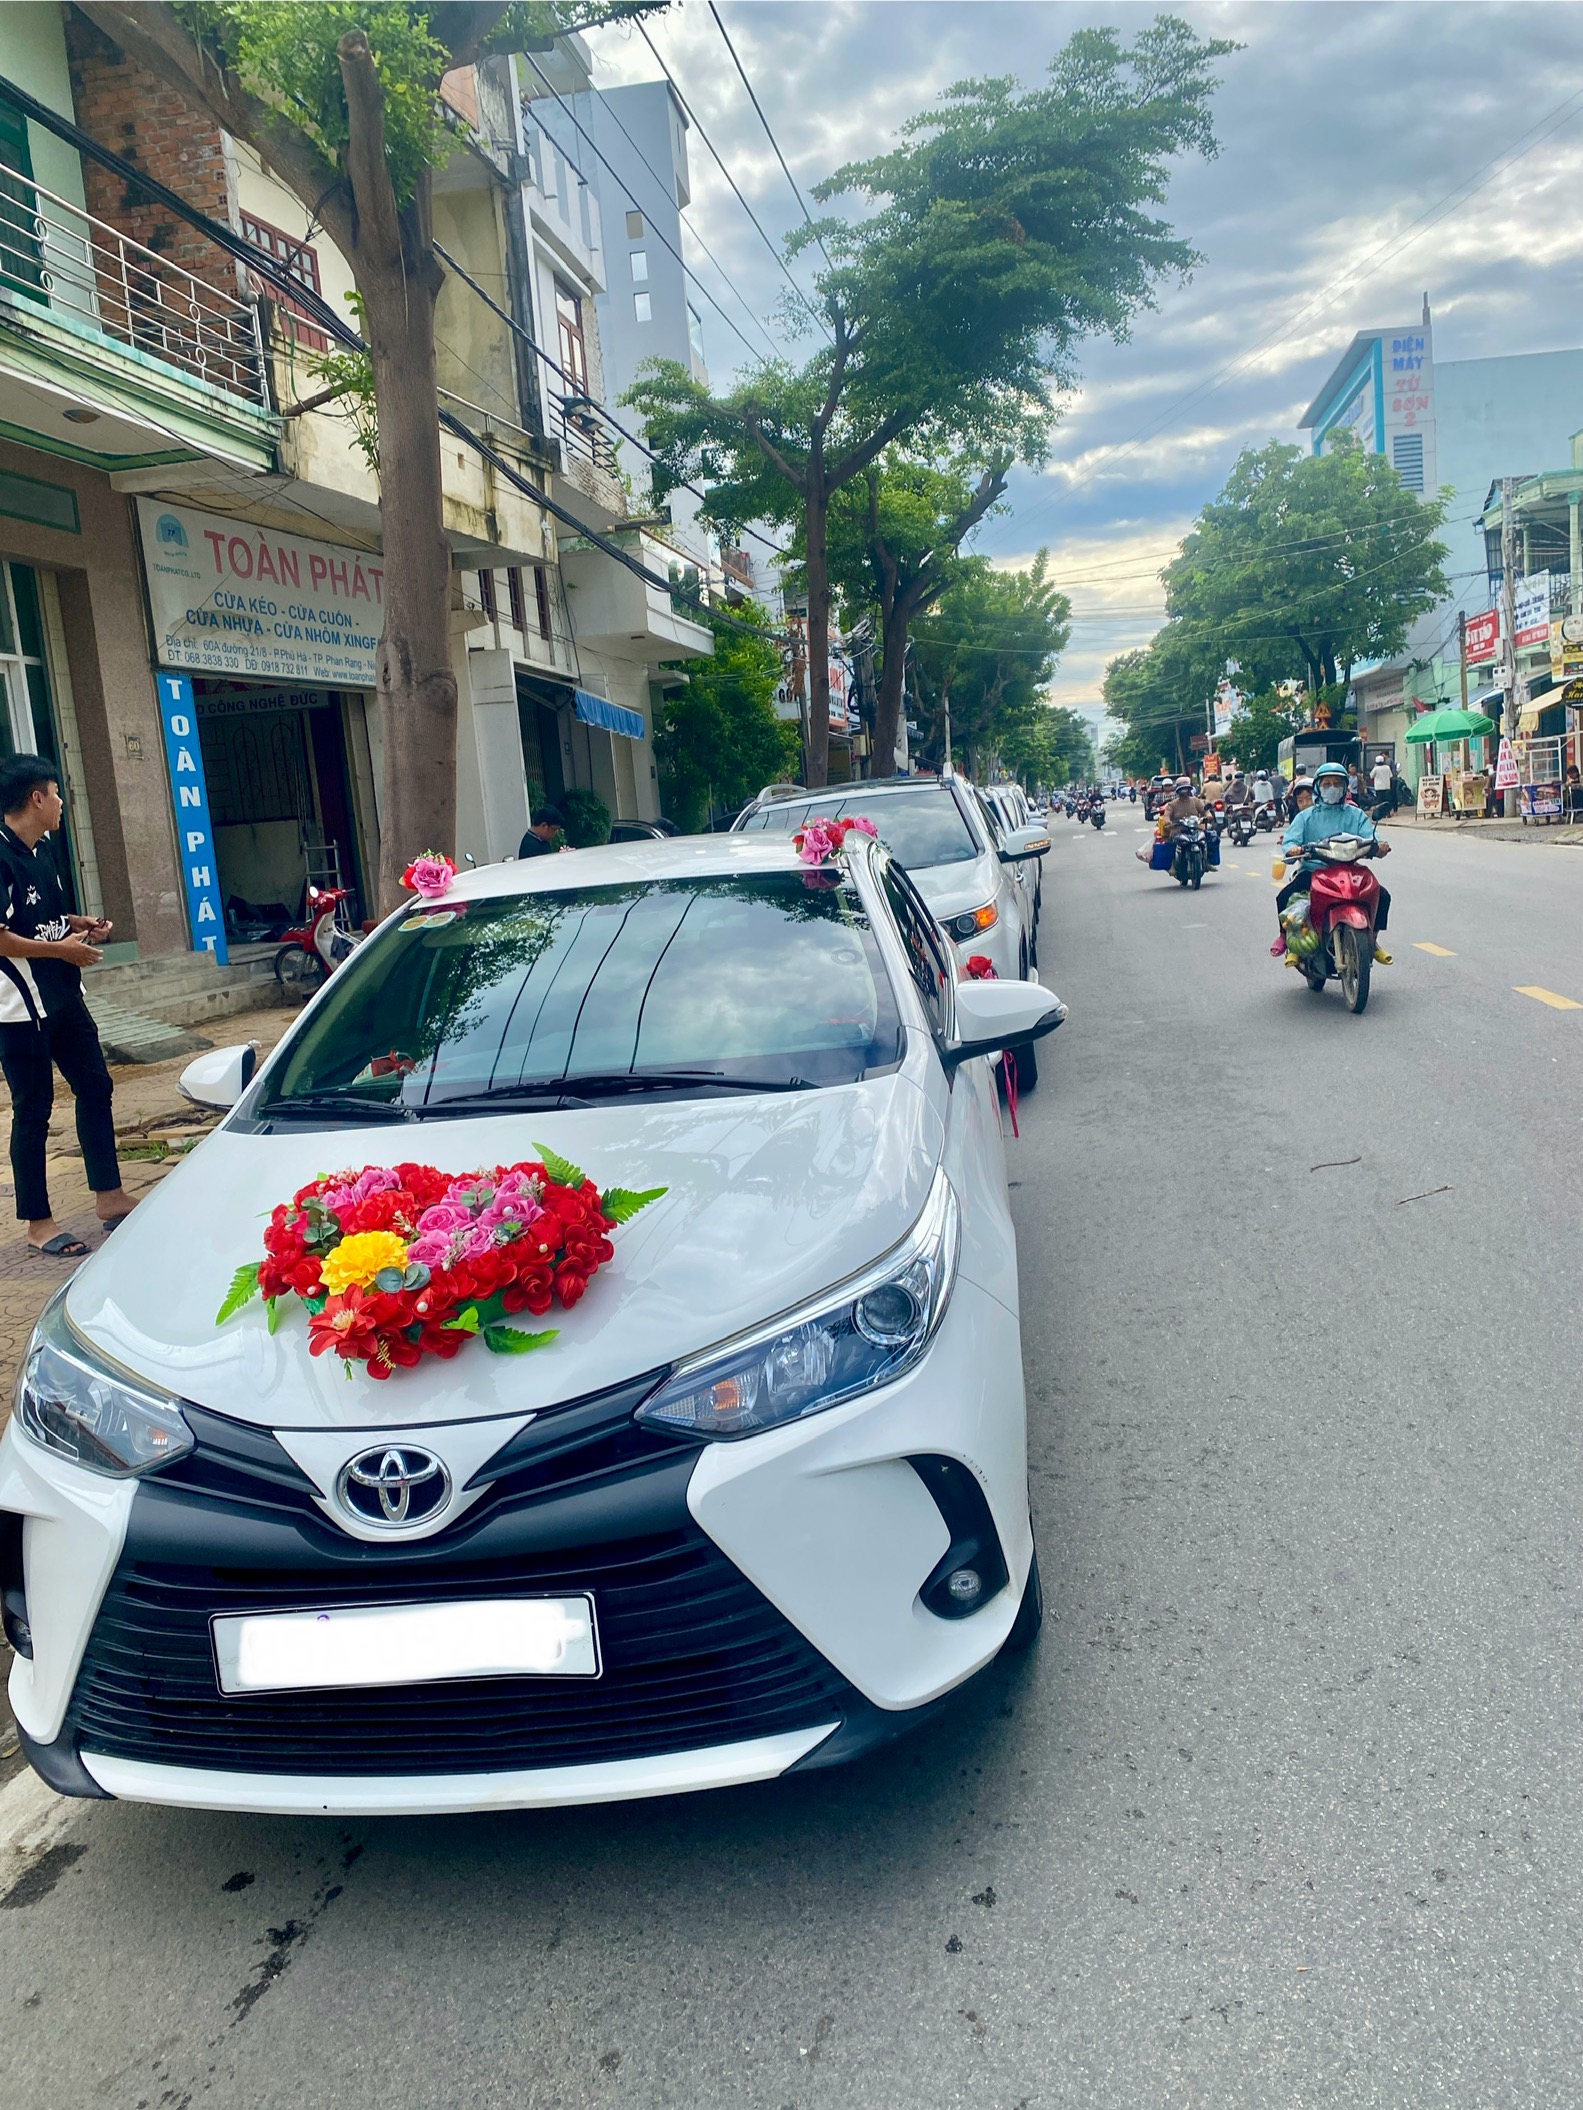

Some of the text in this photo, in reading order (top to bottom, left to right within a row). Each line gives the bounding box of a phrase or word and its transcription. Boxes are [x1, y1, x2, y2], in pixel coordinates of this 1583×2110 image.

[1404, 411, 1416, 426] 2
[203, 530, 384, 605] TOÀN PHÁT
[214, 590, 246, 612] CỬA
[249, 595, 277, 616] KÉO
[288, 603, 316, 622] CỬA
[186, 607, 220, 629] CỬA
[222, 613, 264, 637] NHỰA
[274, 621, 303, 640] CỬA
[305, 627, 341, 646] NHÔM
[203, 640, 220, 652] 60A
[221, 643, 249, 657] đường
[250, 645, 267, 658] 21/8
[325, 655, 343, 667] Phan
[345, 657, 362, 670] Rang
[225, 657, 239, 669] 330
[261, 660, 279, 673] 0918
[281, 663, 294, 675] 732
[208, 699, 245, 714] CÔNG
[249, 693, 285, 710] NGHỆ
[290, 691, 318, 706] ĐỨC
[165, 679, 217, 950] TOÀN PHÁT
